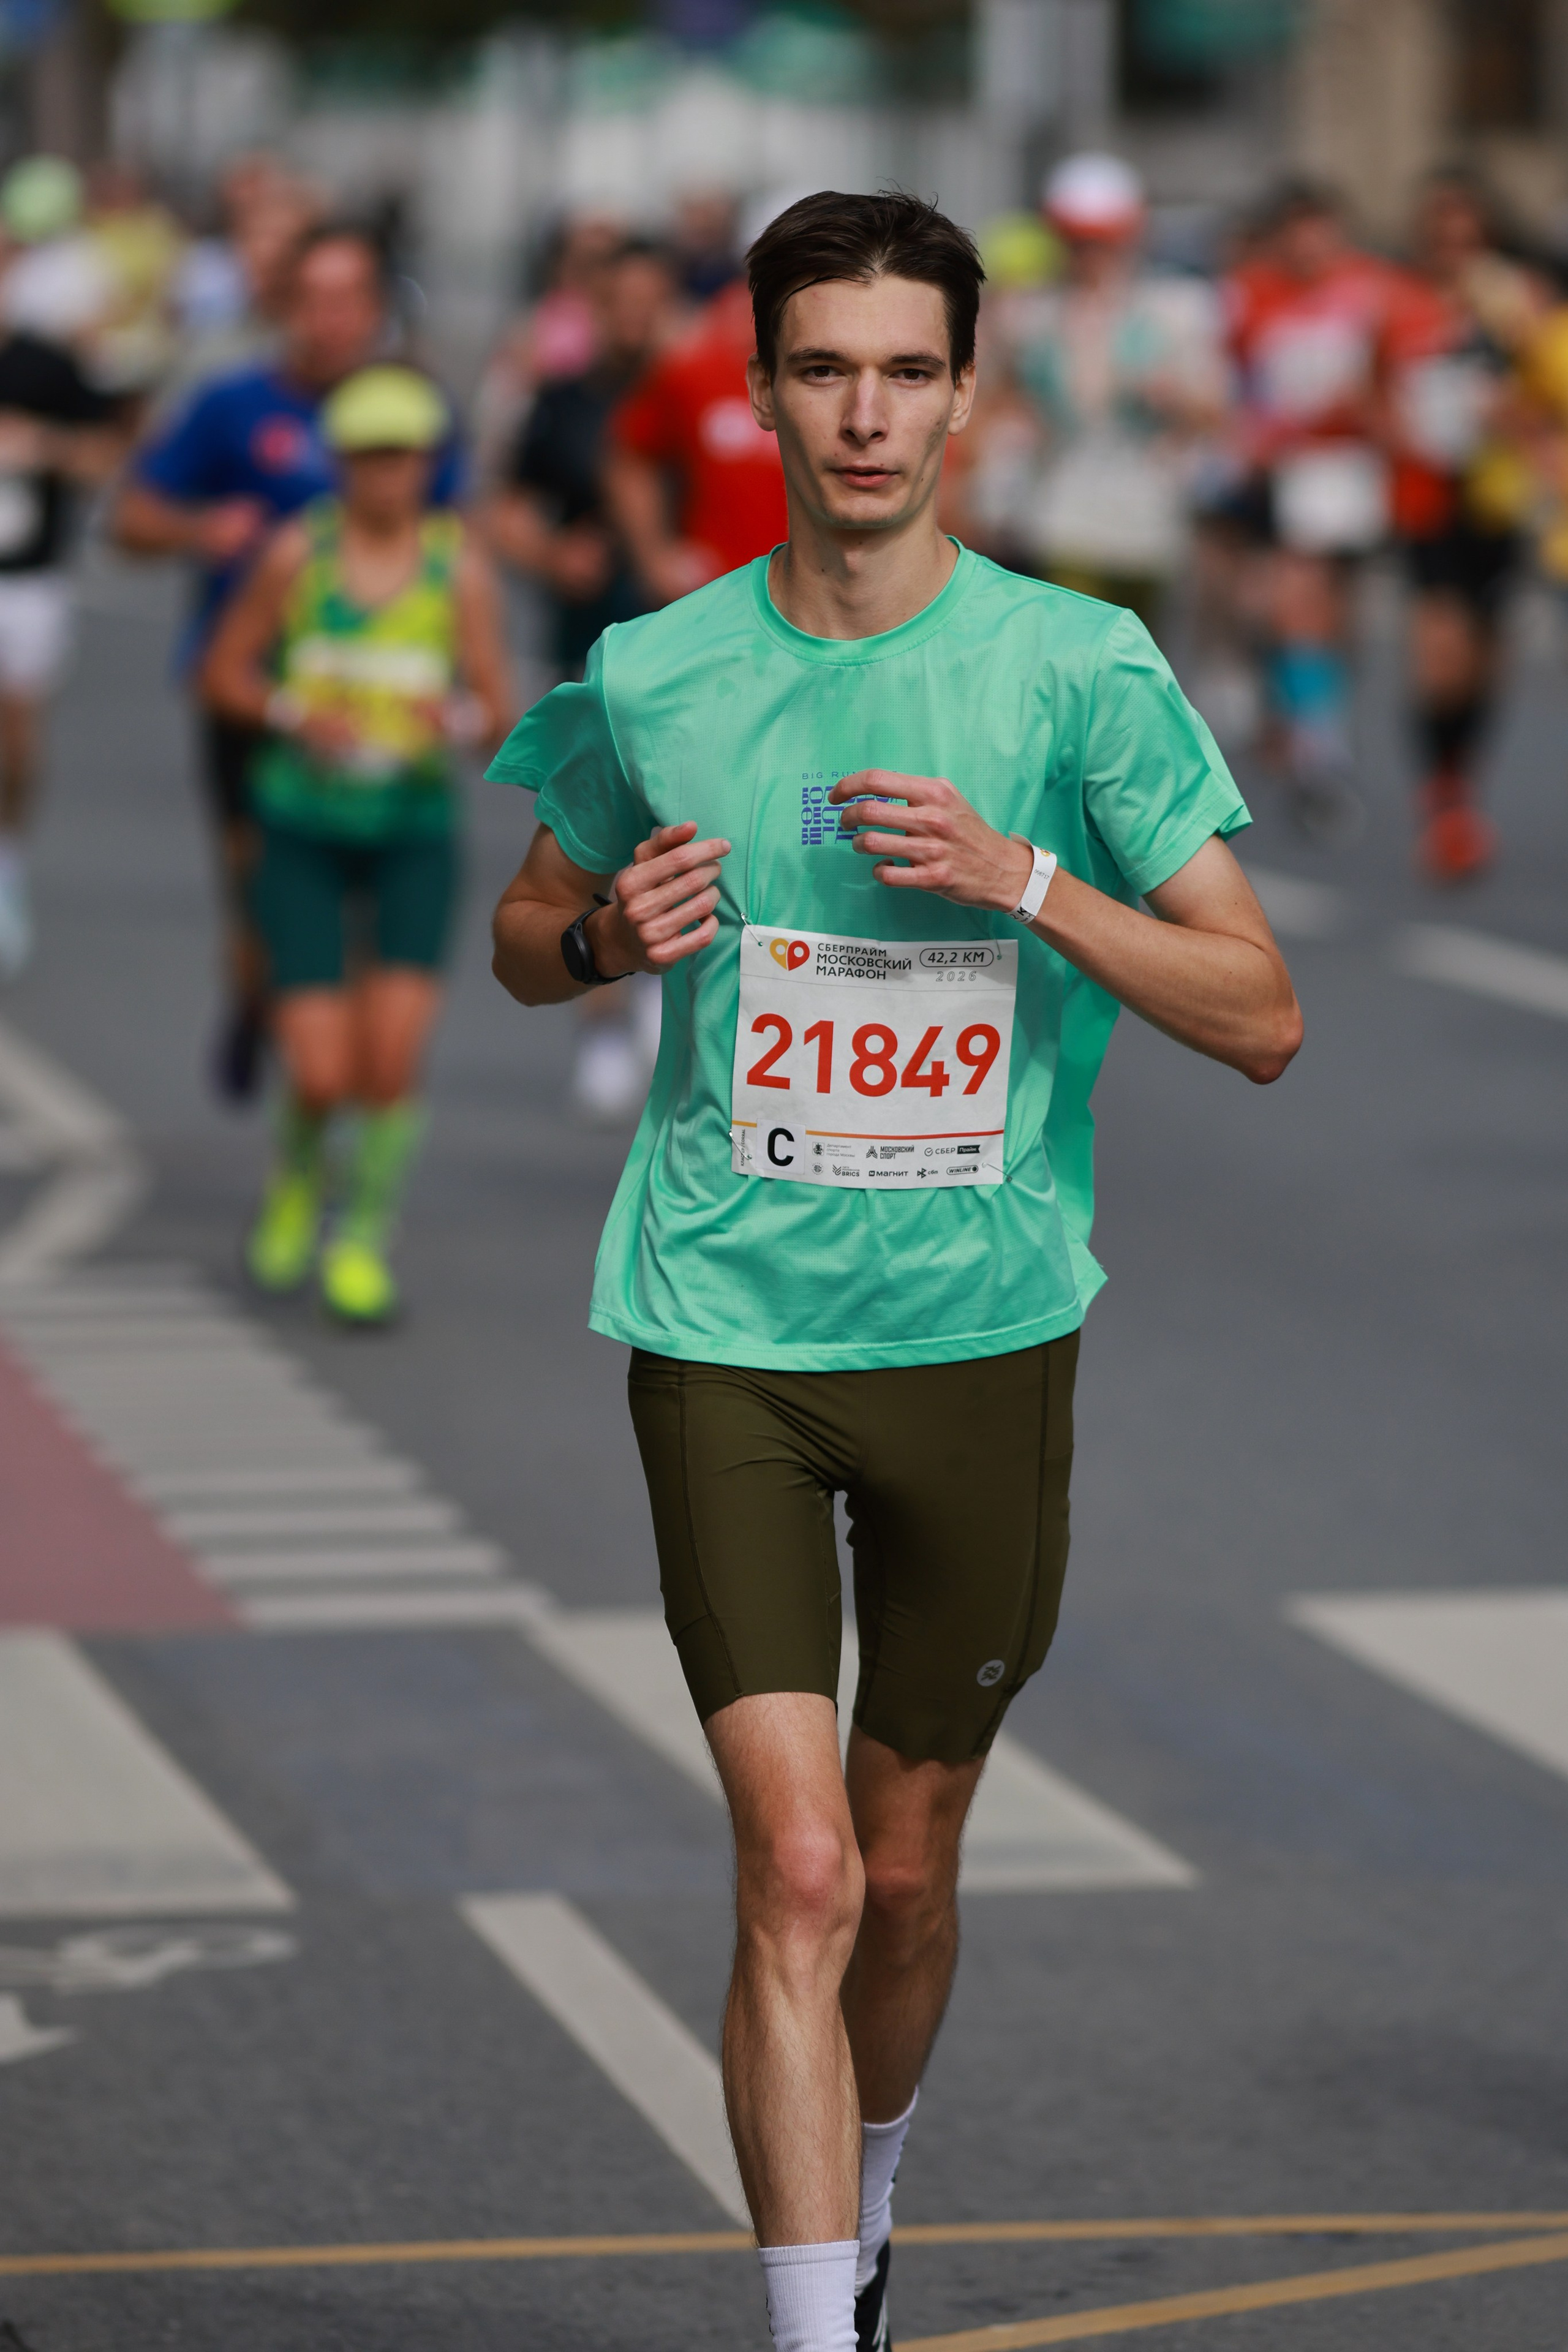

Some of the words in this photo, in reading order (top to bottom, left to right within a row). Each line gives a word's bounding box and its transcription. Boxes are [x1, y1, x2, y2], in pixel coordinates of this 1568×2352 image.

[818, 943, 887, 957] СБЕРПРАЙМ
[816, 953, 912, 970] МОСКОВСКИЙ
[927, 951, 957, 965] 42,2
[816, 966, 886, 980] МАРАФОН
[935, 971, 976, 982] 2026
[746, 1012, 1001, 1098] 21849
